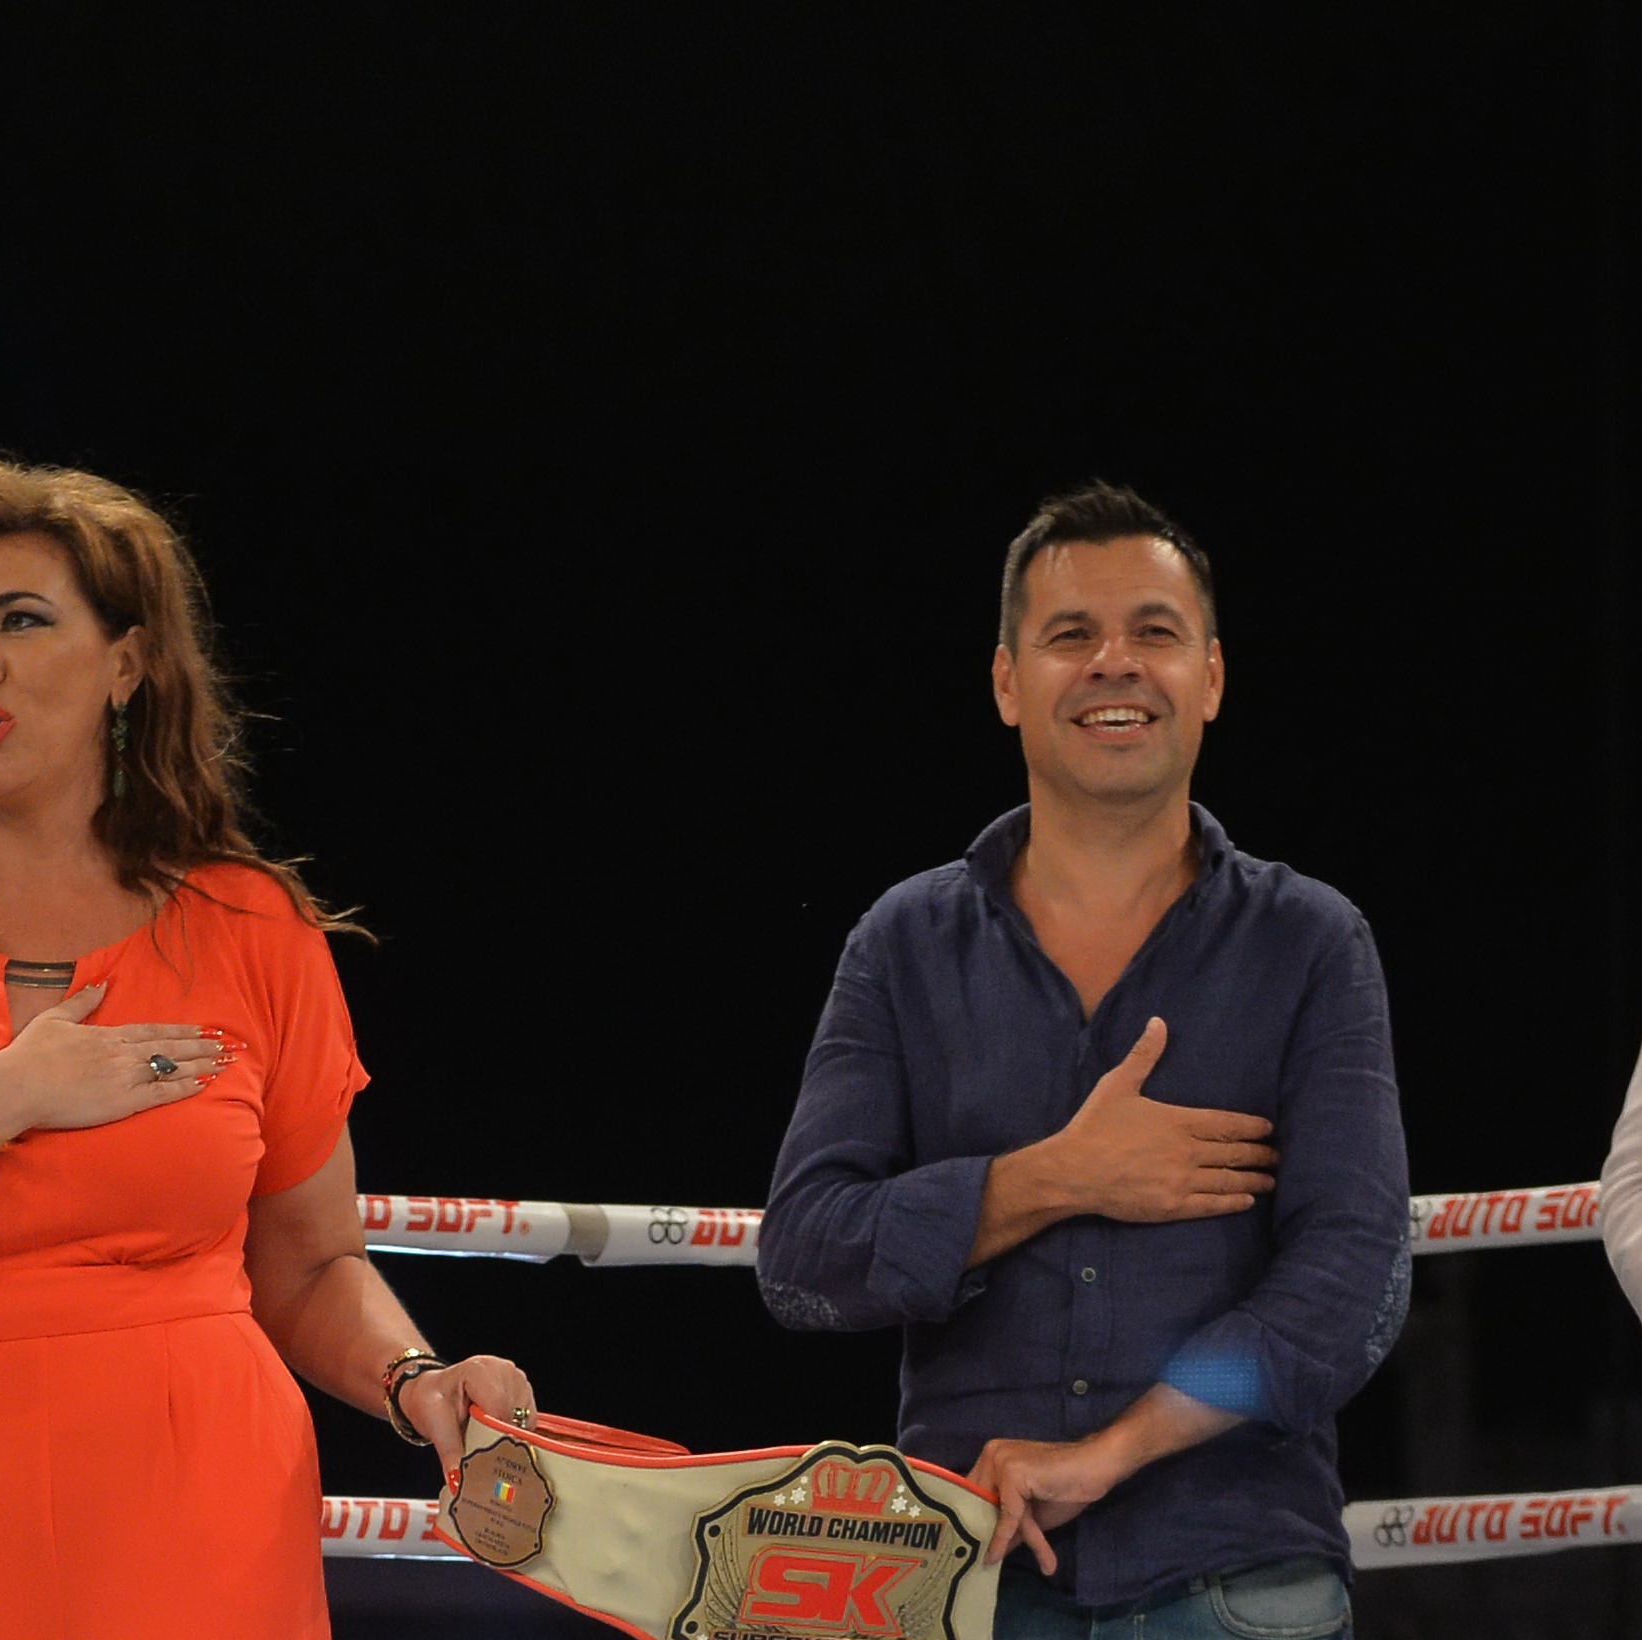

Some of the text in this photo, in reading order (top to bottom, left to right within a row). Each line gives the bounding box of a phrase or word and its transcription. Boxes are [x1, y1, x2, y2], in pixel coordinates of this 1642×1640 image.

[405, 1198, 520, 1234] SOFT
[1427, 1193, 1529, 1240] AUTO
[322, 1499, 410, 1540] UTO
[748, 1507, 943, 1551] WORLD CHAMPION
[1412, 1496, 1629, 1545] AUTO SOFT
